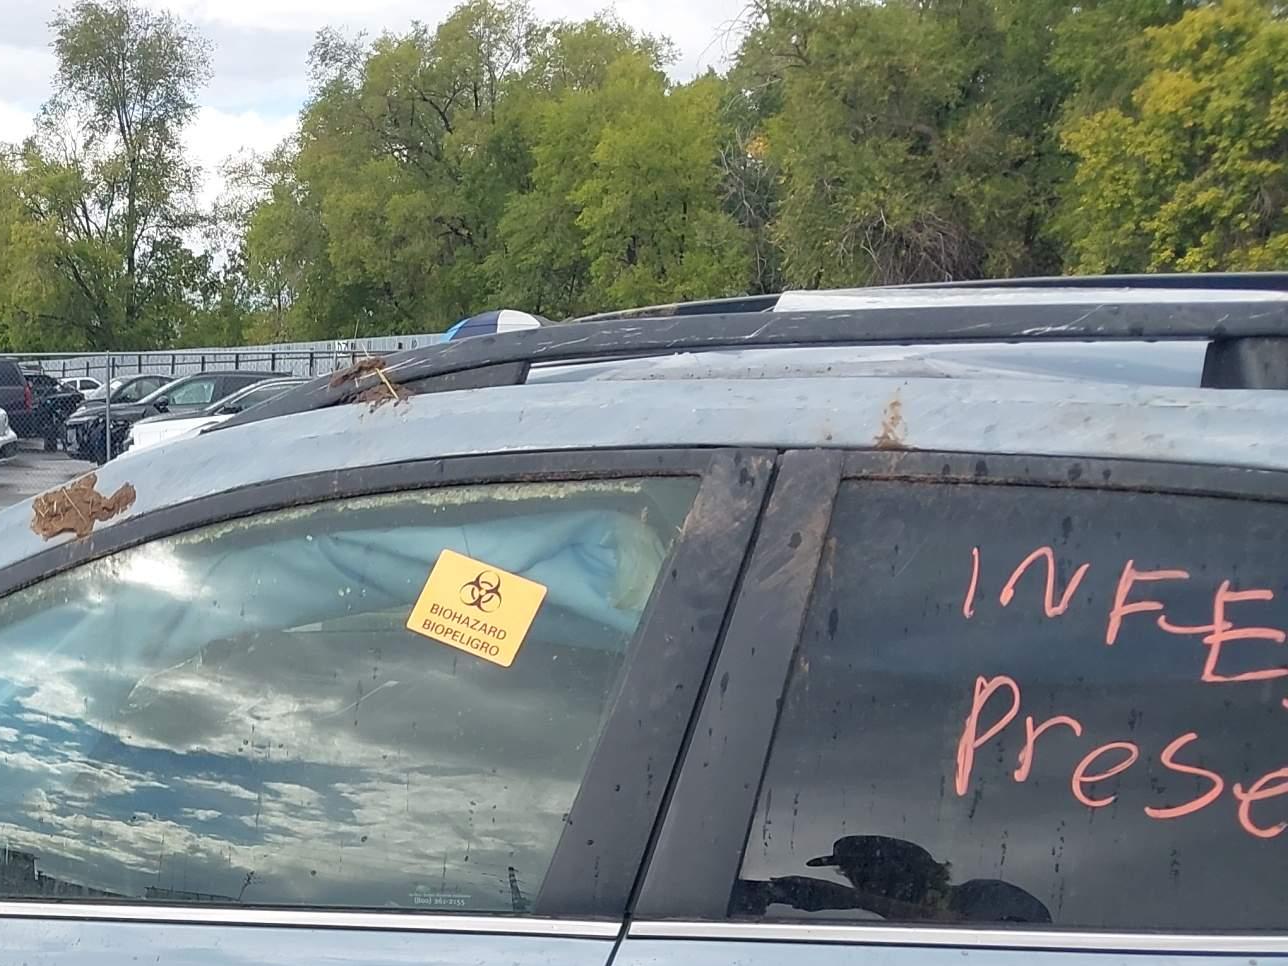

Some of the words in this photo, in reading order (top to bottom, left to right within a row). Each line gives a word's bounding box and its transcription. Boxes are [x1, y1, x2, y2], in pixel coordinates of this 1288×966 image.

[422, 619, 500, 656] BIOPELIGRO
[430, 603, 507, 640] BIOHAZARD
[955, 675, 1288, 838] Prese
